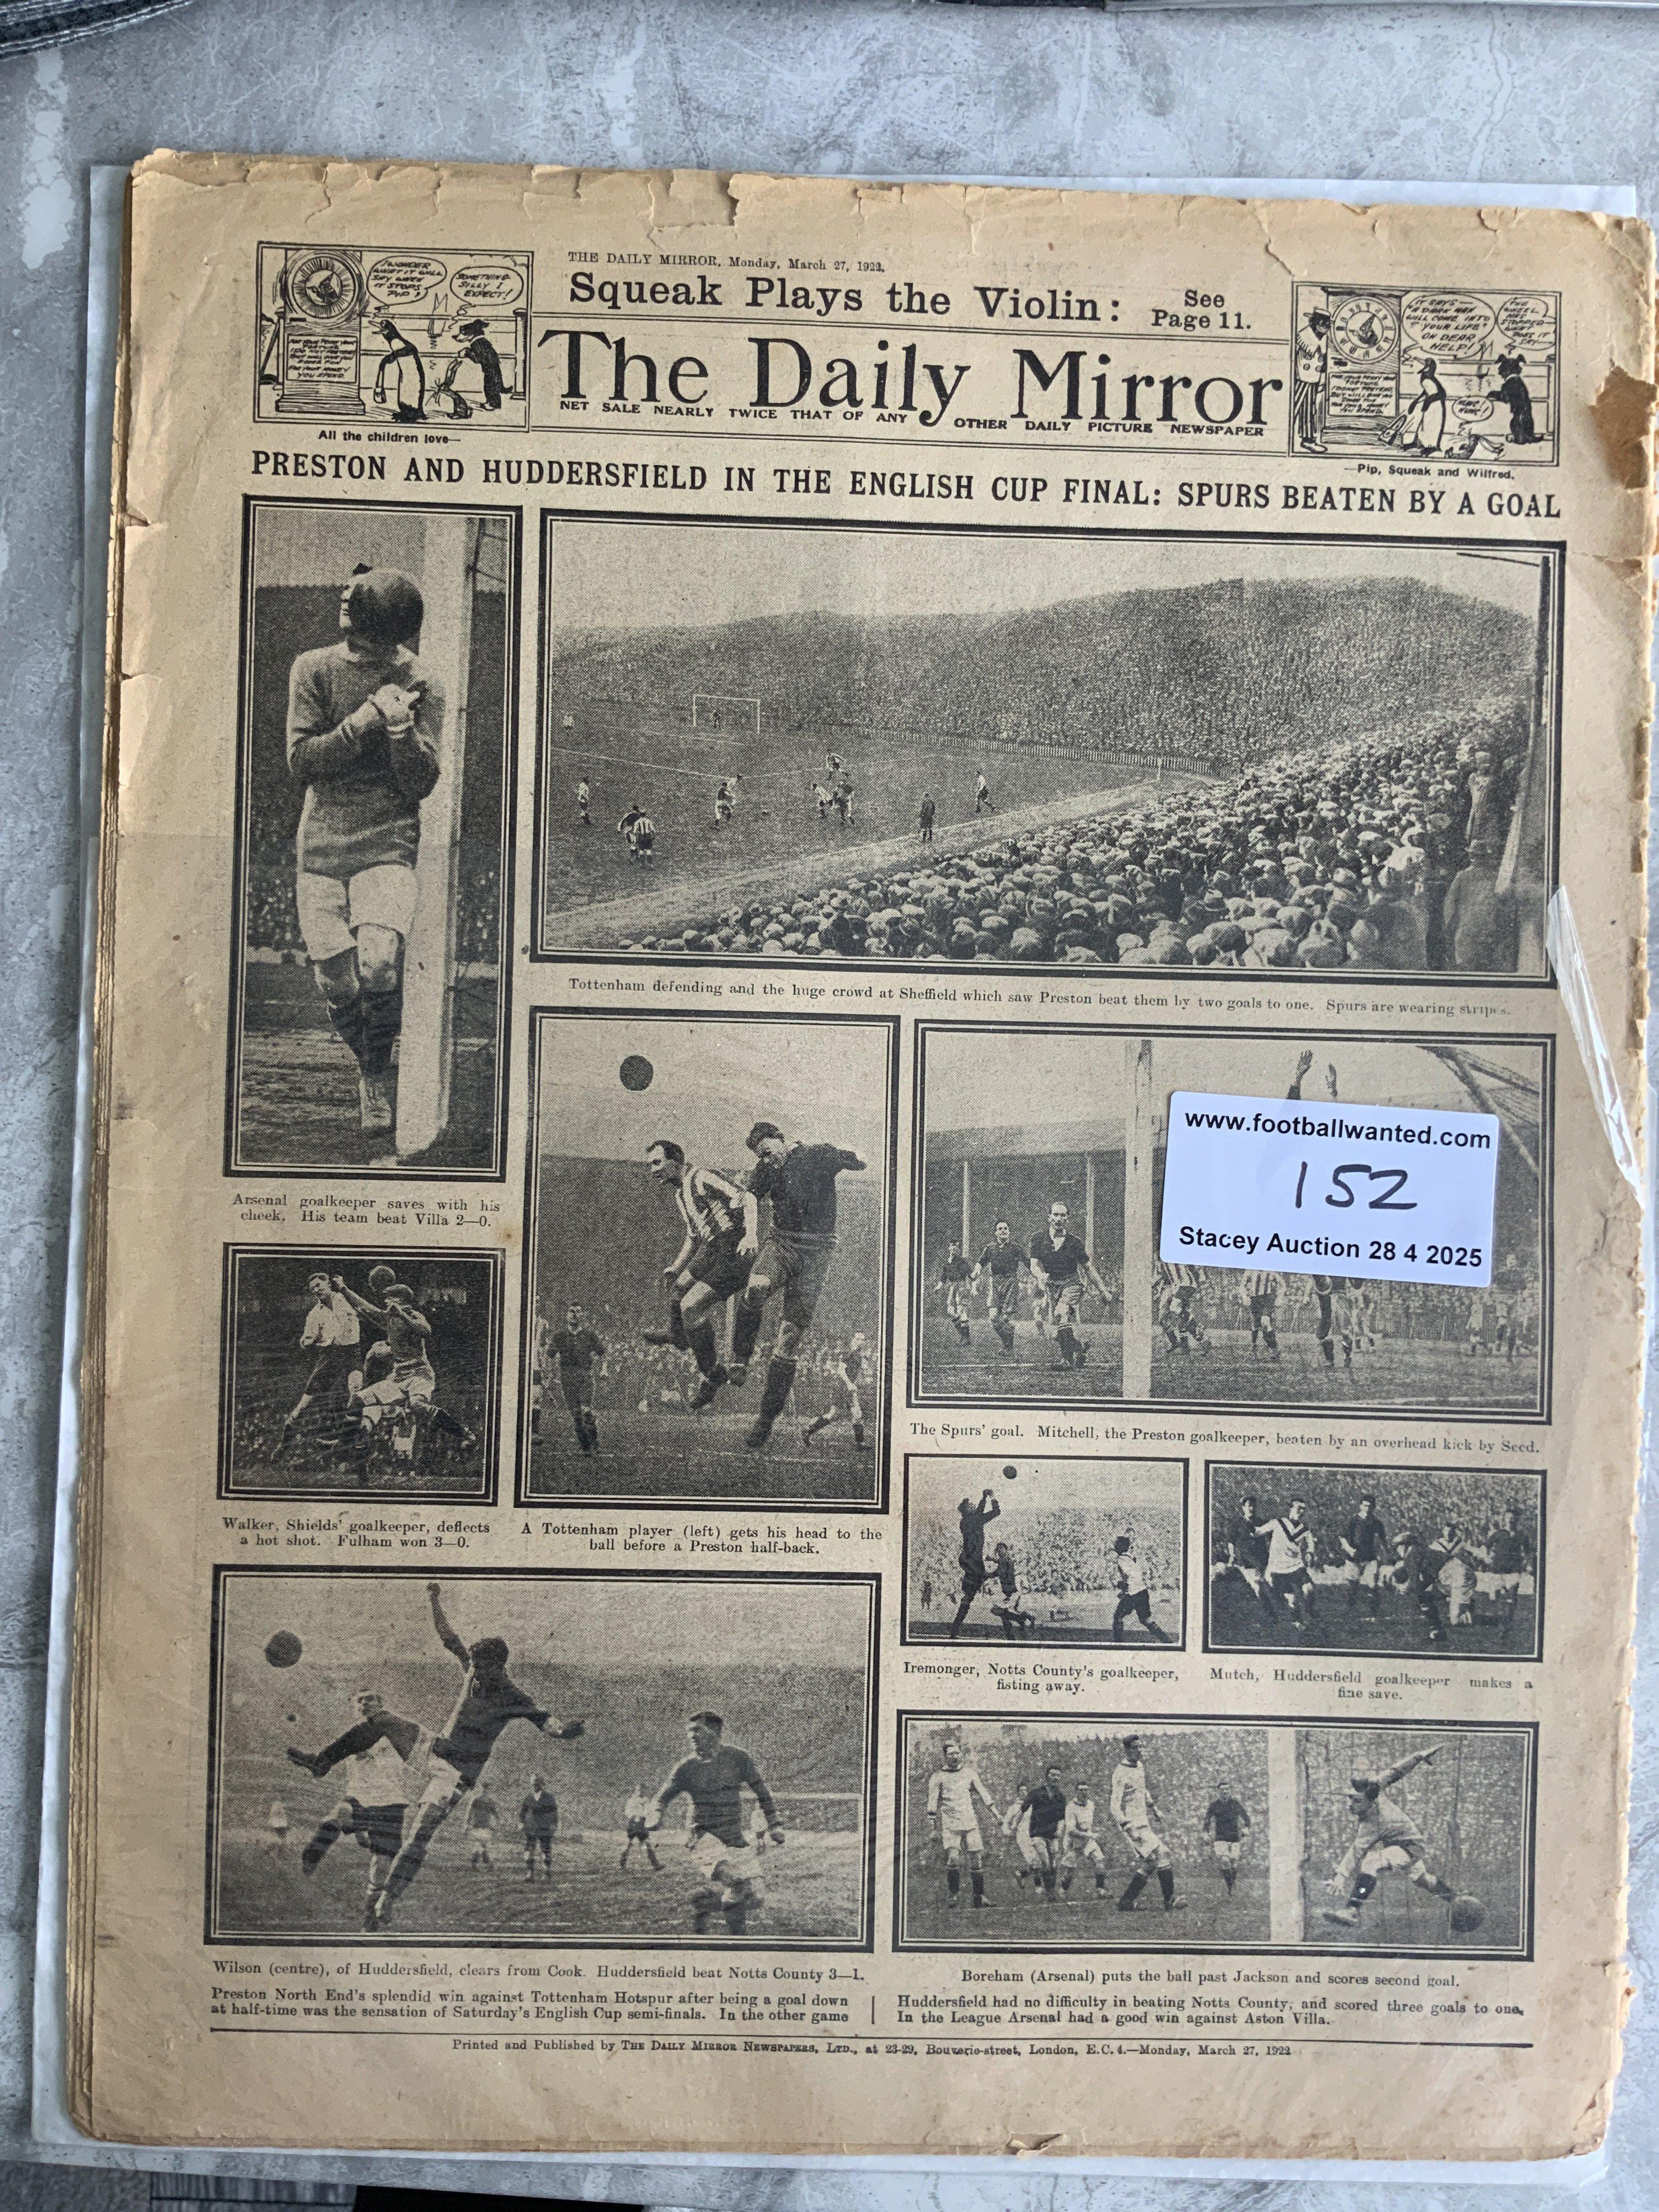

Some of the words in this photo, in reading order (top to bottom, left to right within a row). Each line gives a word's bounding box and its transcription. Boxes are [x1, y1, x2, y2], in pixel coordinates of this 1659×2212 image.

[568, 251, 598, 262] THE
[607, 253, 652, 264] DAILY
[659, 255, 721, 267] MIRROR,
[729, 257, 780, 269] Monday,
[788, 258, 826, 270] March
[834, 261, 849, 272] 27,
[570, 272, 722, 309] Squeak
[746, 277, 862, 317] Plays
[886, 283, 950, 315] the
[1183, 289, 1226, 308] See
[1150, 308, 1211, 331] Page
[1219, 311, 1252, 330] 11.
[537, 329, 709, 404] The
[747, 336, 972, 427] Daily
[1010, 348, 1284, 425] Mirror
[560, 400, 589, 410] NET
[602, 403, 640, 413] SALE
[654, 406, 713, 417] NEARLY
[729, 409, 777, 419] TWICE
[791, 410, 832, 419] THAT
[843, 411, 864, 420] OF
[876, 413, 907, 423] ANY
[954, 418, 1007, 430] OTHER
[1025, 421, 1071, 431] DAILY
[1088, 422, 1153, 433] PICTURE
[1171, 424, 1263, 436] NEWSPAPER
[318, 430, 336, 439] All
[343, 431, 362, 441] the
[368, 432, 418, 443] children
[1389, 465, 1431, 476] Squeak
[1438, 468, 1459, 477] and
[1467, 469, 1514, 479] Wilfred.
[252, 450, 386, 479] PRESTON
[404, 458, 464, 482] AND
[483, 460, 706, 490] HUDDERSFIELD
[724, 467, 755, 491] IN
[774, 466, 831, 494] THE
[849, 471, 973, 499] ENGLISH
[992, 477, 1047, 501] CUP
[1063, 479, 1160, 505] FINAL:
[1178, 482, 1269, 509] SPURS
[1282, 486, 1395, 512] BEATEN
[1409, 490, 1446, 514] BY
[1457, 492, 1475, 515] A
[1488, 493, 1560, 518] GOAL
[1185, 1113, 1490, 1148] www.footballwanted.com
[1295, 1161, 1418, 1210] 152
[233, 1193, 287, 1205] Arsenal
[300, 1195, 376, 1210] goalkeeper
[387, 1201, 424, 1209] saves
[437, 1199, 467, 1210] with
[481, 1200, 499, 1211] his
[241, 1210, 285, 1221] cheek.
[301, 1211, 325, 1222] His
[334, 1212, 368, 1223] team
[377, 1212, 407, 1224] beat
[415, 1213, 449, 1226] Villa
[1180, 1226, 1259, 1254] Stacey
[1267, 1233, 1359, 1257] Auction
[1369, 1241, 1395, 1260] 28
[1404, 1244, 1417, 1262] 4
[1426, 1245, 1481, 1267] 2025
[910, 1423, 935, 1435] The
[991, 1425, 1023, 1439] goal.
[1038, 1425, 1098, 1440] Mitchell,
[1105, 1427, 1126, 1439] the
[1132, 1428, 1184, 1441] Preston
[1190, 1431, 1269, 1446] goalkeeper,
[1277, 1433, 1322, 1445] beaten
[1329, 1435, 1344, 1449] by
[1374, 1437, 1436, 1448] overhead
[1443, 1438, 1472, 1450] kick
[1480, 1440, 1494, 1453] by
[222, 1518, 279, 1531] Walker,
[349, 1520, 430, 1534] goalkeeper,
[437, 1521, 489, 1533] deflects
[521, 1522, 532, 1534] A
[542, 1523, 618, 1535] Tottenham
[629, 1524, 673, 1538] player
[684, 1525, 720, 1539] (left)
[729, 1527, 758, 1540] gets
[768, 1526, 786, 1538] his
[795, 1527, 827, 1539] head
[837, 1528, 850, 1539] to
[860, 1528, 882, 1539] the
[256, 1534, 278, 1545] hot
[287, 1534, 320, 1545] shot.
[337, 1535, 392, 1547] Fulham
[590, 1538, 614, 1550] ball
[624, 1539, 665, 1551] before
[690, 1540, 742, 1552] Preston
[751, 1541, 819, 1554] half-back.
[904, 1662, 979, 1678] Iremonger,
[988, 1663, 1025, 1675] Notts
[1033, 1664, 1093, 1680] County's
[1101, 1667, 1178, 1682] goalkeeper,
[997, 1679, 1040, 1694] fisting
[1046, 1683, 1084, 1695] away.
[213, 1961, 261, 1973] Wilson
[269, 1962, 329, 1977] (centre),
[337, 1963, 351, 1974] of
[359, 1963, 452, 1978] Huddersfield,
[460, 1963, 499, 1976] clears
[507, 1965, 540, 1976] from
[597, 1966, 686, 1978] Huddersfield
[692, 1966, 722, 1978] beat
[729, 1967, 767, 1979] Notts
[773, 1967, 823, 1983] County
[962, 1970, 1023, 1982] Boreham
[1031, 1970, 1094, 1984] (Arsenal)
[1102, 1971, 1132, 1985] puts
[1138, 1971, 1160, 1981] the
[1167, 1971, 1192, 1982] ball
[1199, 1972, 1227, 1985] past
[1233, 1972, 1288, 1983] Jackson
[1296, 1972, 1321, 1983] and
[1328, 1976, 1368, 1984] scores
[1375, 1975, 1419, 1985] second
[1428, 1975, 1459, 1987] goal.
[212, 1987, 266, 1999] Preston
[275, 1988, 317, 2000] North
[325, 1989, 365, 2001] End's
[373, 1989, 430, 2004] splendid
[439, 1990, 464, 2001] win
[472, 1990, 523, 2005] against
[531, 1991, 607, 2003] Tottenham
[614, 1991, 673, 2006] Hotspur
[678, 1992, 714, 2004] after
[720, 1992, 758, 2007] being
[764, 1996, 771, 2005] a
[777, 1993, 806, 2008] goal
[812, 1994, 848, 2006] down
